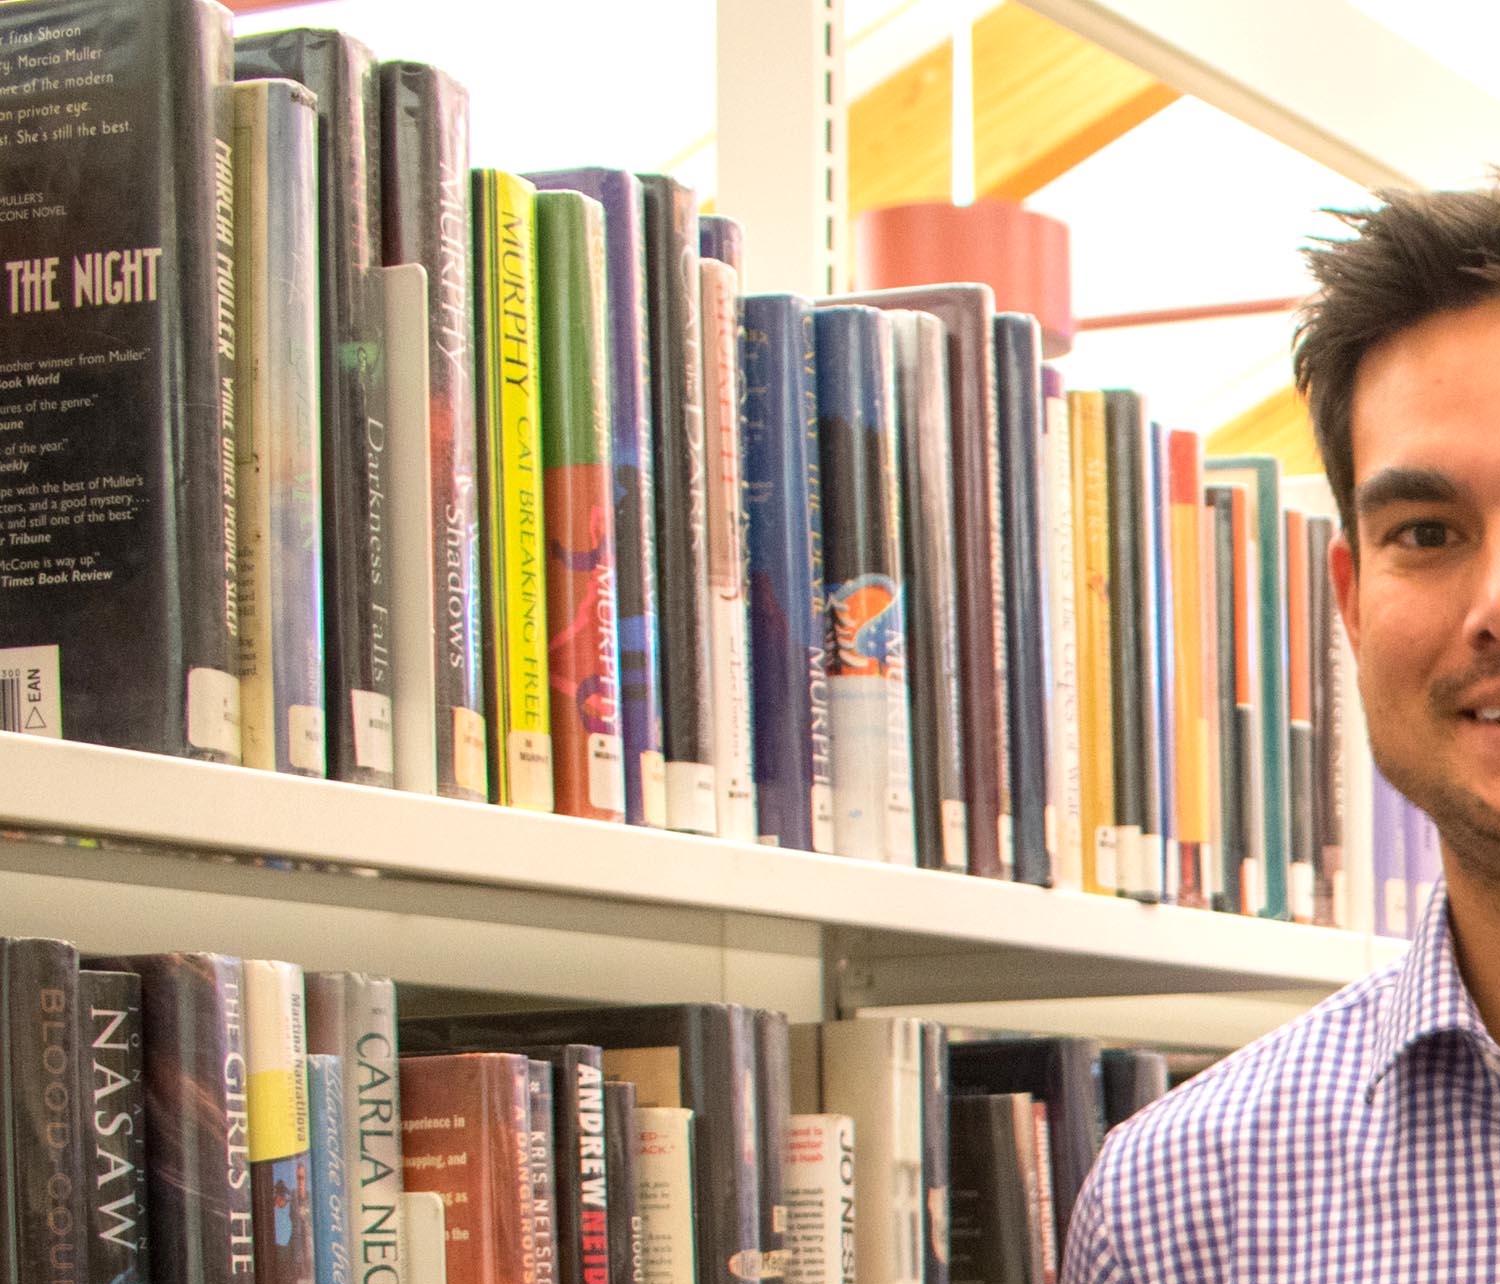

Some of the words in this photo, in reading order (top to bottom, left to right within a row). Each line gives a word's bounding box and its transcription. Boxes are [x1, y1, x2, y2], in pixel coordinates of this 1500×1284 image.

[18, 51, 62, 69] Marcia
[65, 72, 115, 89] modern
[18, 102, 61, 124] private
[53, 124, 73, 141] still
[78, 123, 97, 139] the
[214, 136, 236, 247] MARCIA
[6, 257, 60, 315] THE
[73, 247, 163, 309] NIGHT
[439, 162, 469, 374] MURPHY
[216, 254, 236, 361] MULLER
[501, 209, 531, 398] MURPHY
[26, 373, 61, 387] World
[38, 356, 75, 370] winner
[79, 352, 105, 367] from
[222, 437, 236, 502] OTHER
[516, 415, 535, 473] CAT
[40, 480, 58, 495] the
[62, 478, 86, 493] best
[88, 476, 101, 490] of
[50, 513, 71, 526] one
[88, 509, 106, 523] the
[61, 495, 87, 513] good
[365, 417, 388, 587] Darkness
[9, 530, 52, 546] Tribune
[55, 557, 77, 573] way
[222, 503, 238, 575] PEOPLE
[518, 488, 540, 646] BREAKING
[2, 574, 36, 589] Times
[38, 570, 69, 586] Book
[72, 567, 114, 582] Review
[224, 578, 239, 637] SLEEP
[444, 504, 472, 670] Shadows
[369, 602, 390, 684] Falls
[27, 667, 42, 704] EAN
[523, 656, 541, 728] FREE
[222, 978, 240, 1043] THE
[40, 988, 70, 1150] BLOOD
[91, 1006, 139, 1252] NASAW
[223, 1050, 250, 1192] GIRLS
[355, 1030, 396, 1188] CARLA
[576, 1062, 608, 1210] ANDREW
[530, 1130, 549, 1184] KRIS
[838, 1130, 857, 1190] JO
[229, 1211, 255, 1275] HE
[631, 1214, 644, 1283] Blood
